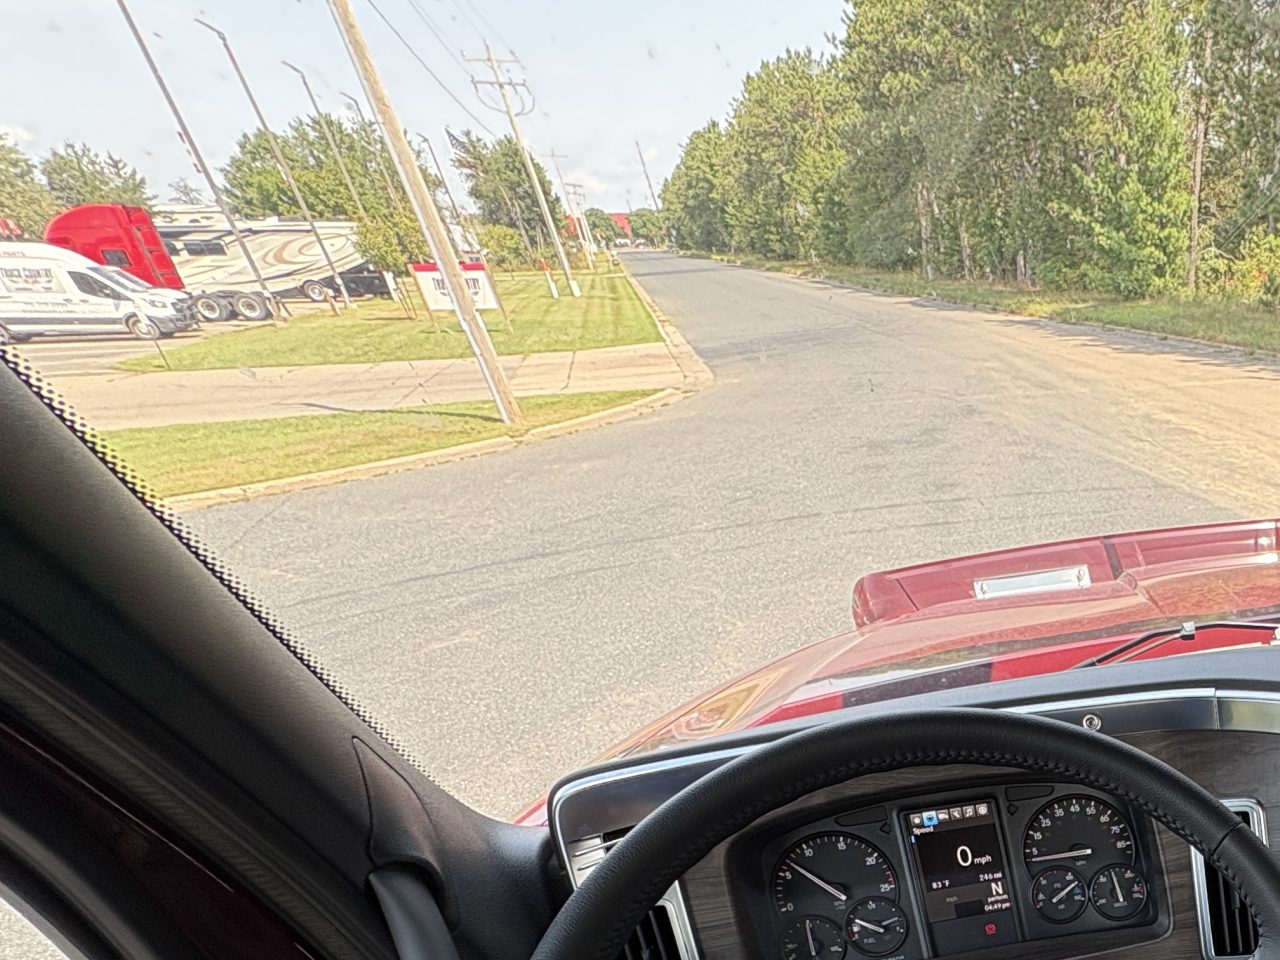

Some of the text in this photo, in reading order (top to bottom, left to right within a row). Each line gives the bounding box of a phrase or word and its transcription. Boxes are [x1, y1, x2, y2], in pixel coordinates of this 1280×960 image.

[1055, 808, 1065, 817] 35
[1070, 804, 1080, 812] 45
[1086, 807, 1096, 815] 55
[1041, 818, 1051, 827] 25
[1100, 815, 1110, 823] 65
[912, 825, 935, 836] Speed
[1110, 825, 1121, 834] 75
[1034, 831, 1042, 840] 15
[837, 841, 847, 851] 15
[804, 848, 814, 858] 10
[956, 845, 993, 867] 0 mph
[1032, 847, 1039, 856] 5
[865, 856, 877, 866] 20
[785, 870, 793, 880] 5
[880, 883, 892, 893] 25
[990, 881, 1004, 896] N
[787, 902, 794, 911] 0
